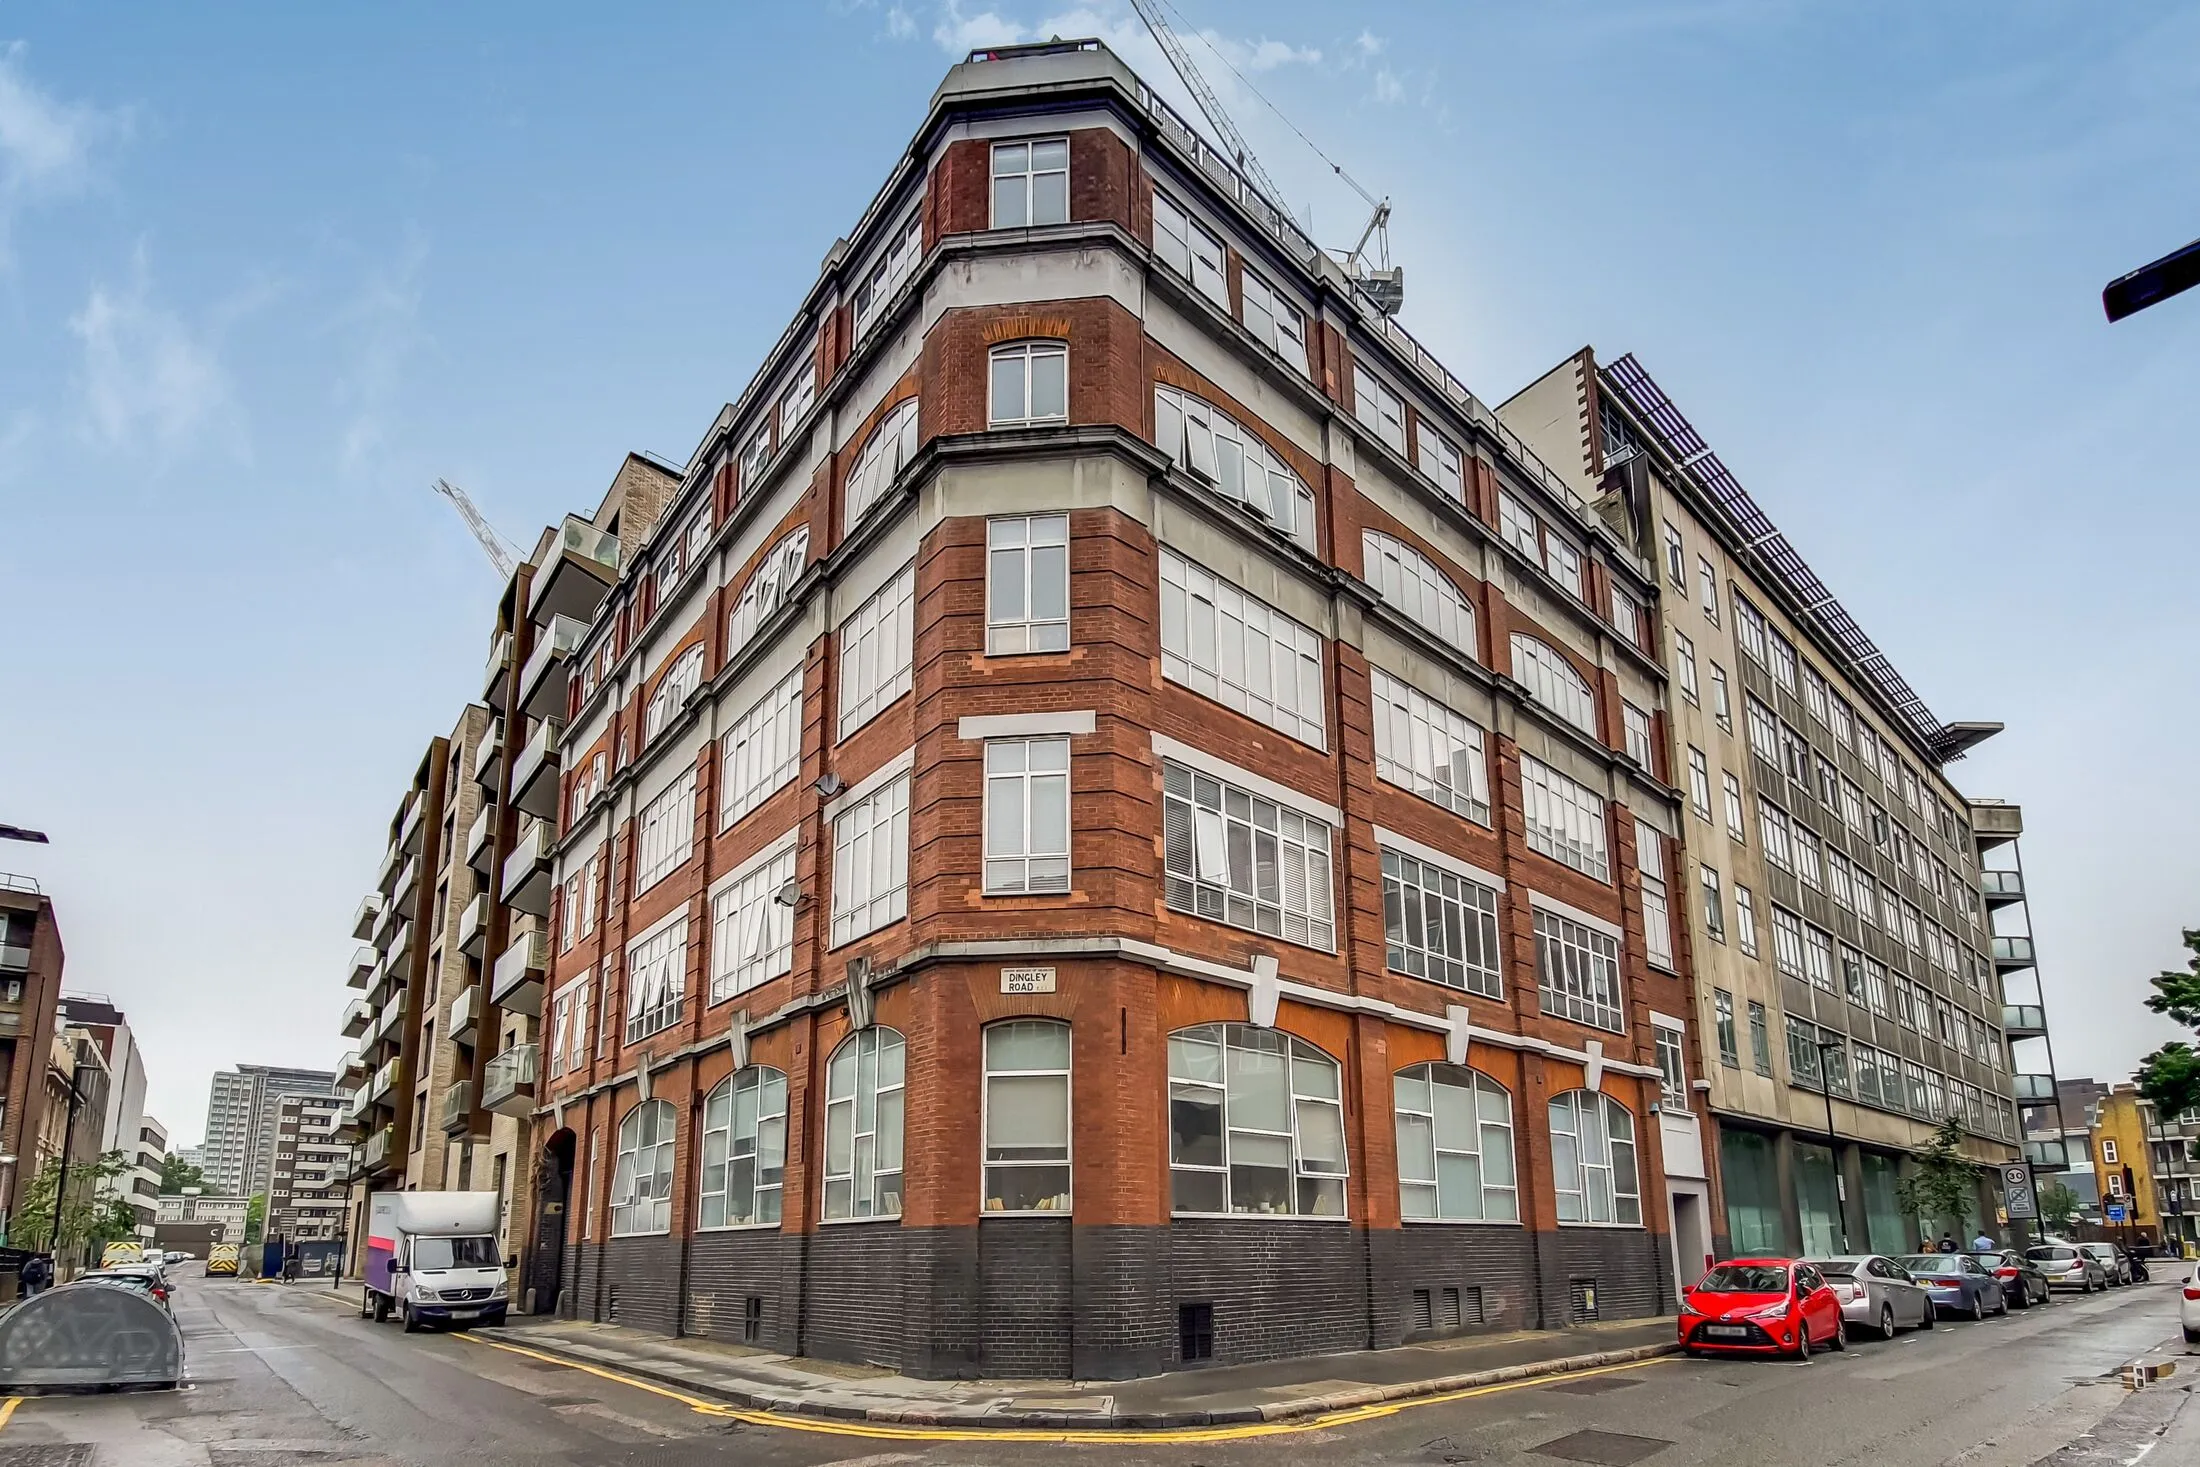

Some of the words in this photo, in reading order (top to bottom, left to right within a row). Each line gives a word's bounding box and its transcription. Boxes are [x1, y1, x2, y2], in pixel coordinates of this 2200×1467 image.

[1009, 973, 1047, 982] DINGLEY
[1009, 983, 1034, 991] ROAD
[2009, 1172, 2023, 1180] 30
